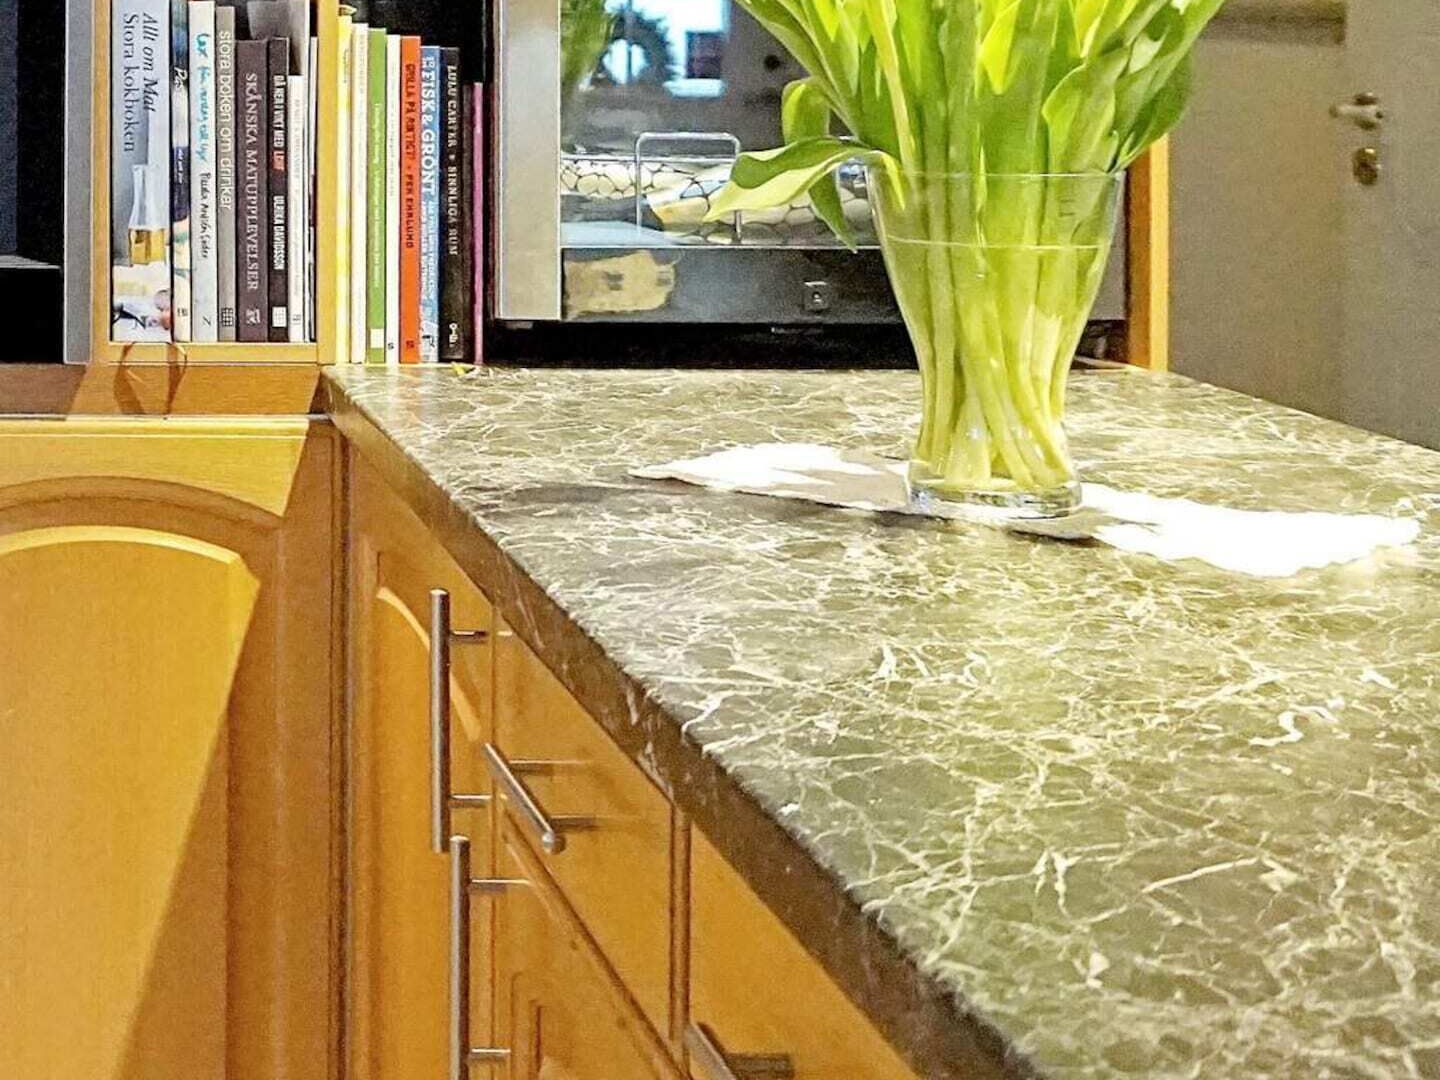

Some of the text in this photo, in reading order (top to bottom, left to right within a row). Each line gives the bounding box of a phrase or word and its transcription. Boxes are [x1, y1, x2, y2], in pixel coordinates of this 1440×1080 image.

[142, 12, 160, 113] Allt om Mat
[220, 30, 234, 69] stora
[123, 13, 140, 152] Stora kokboken
[220, 74, 234, 122] boken
[421, 70, 436, 111] FISK
[220, 127, 232, 153] om
[273, 130, 286, 148] MED
[421, 114, 434, 125] &
[245, 72, 262, 292] SKÅNSKA MATUPPLEVELSER
[421, 129, 438, 196] GRÖNT
[446, 65, 459, 256] LULU CARTER SINNLIGA RUM
[272, 195, 286, 225] ULRIKA
